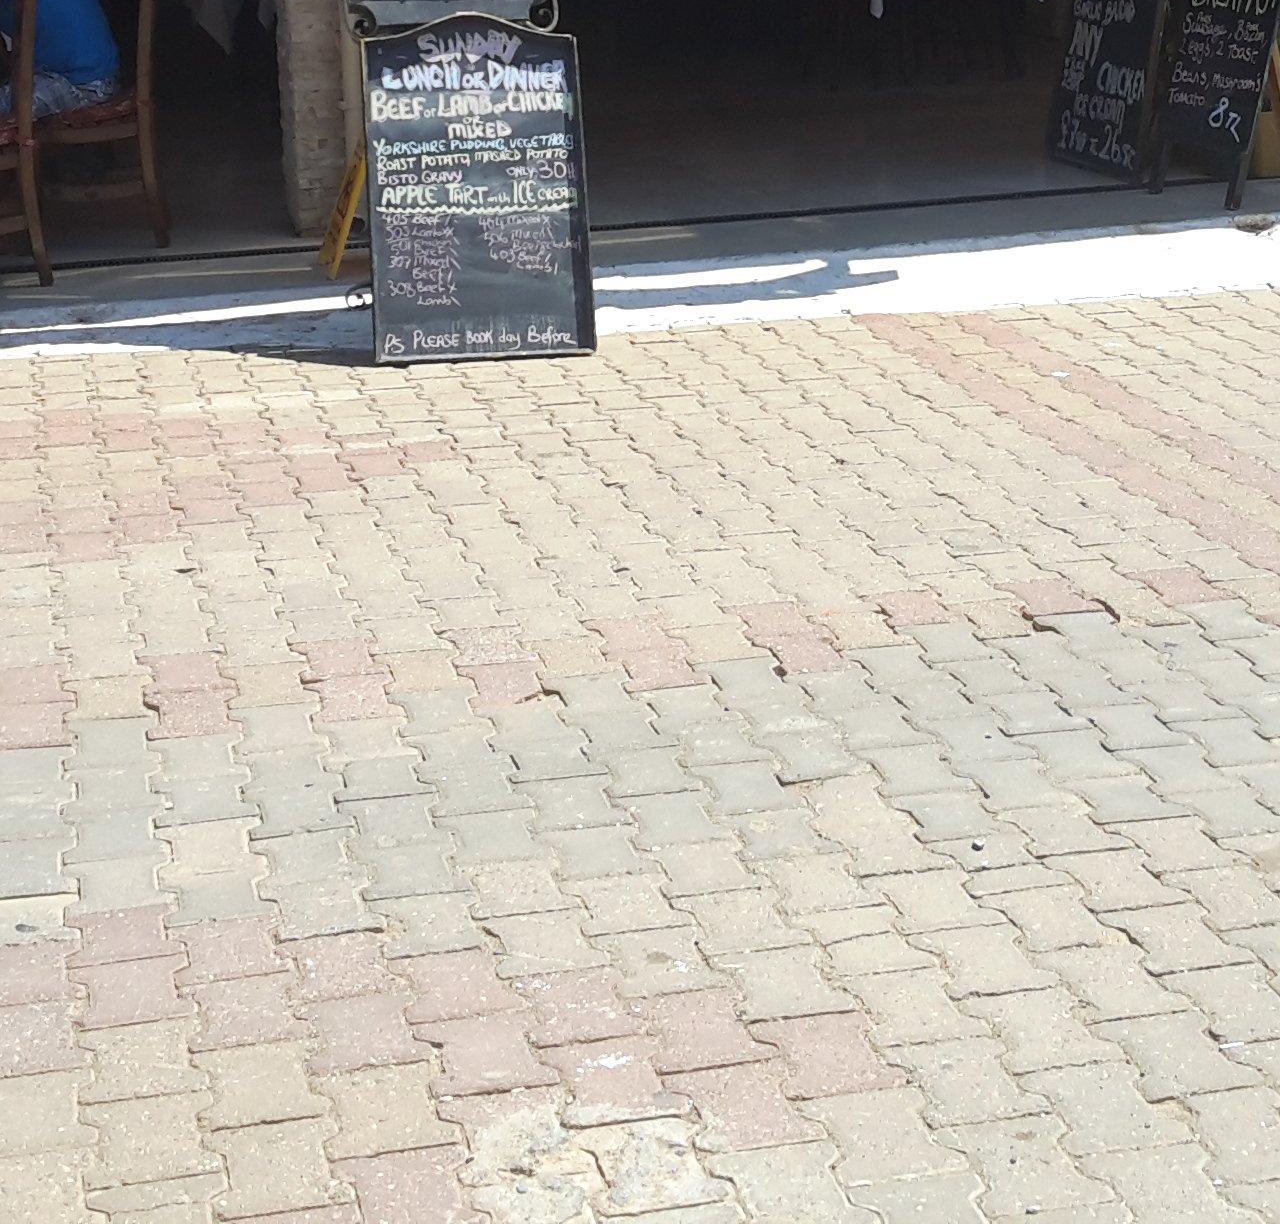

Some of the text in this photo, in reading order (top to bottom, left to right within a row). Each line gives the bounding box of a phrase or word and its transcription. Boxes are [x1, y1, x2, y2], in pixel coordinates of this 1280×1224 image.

[417, 30, 522, 64] SUNDAY
[381, 61, 461, 92] LUNCH
[487, 60, 569, 93] DINNER
[437, 92, 493, 118] LAMB
[445, 120, 512, 140] MIXED
[372, 137, 447, 156] YORKSHIRE
[376, 155, 417, 171] ROAST
[381, 184, 438, 206] APPLE
[445, 182, 489, 205] TART
[513, 180, 536, 204] ICE
[413, 329, 461, 350] PLEASE
[465, 329, 494, 345] BOOK
[527, 325, 577, 348] Before
